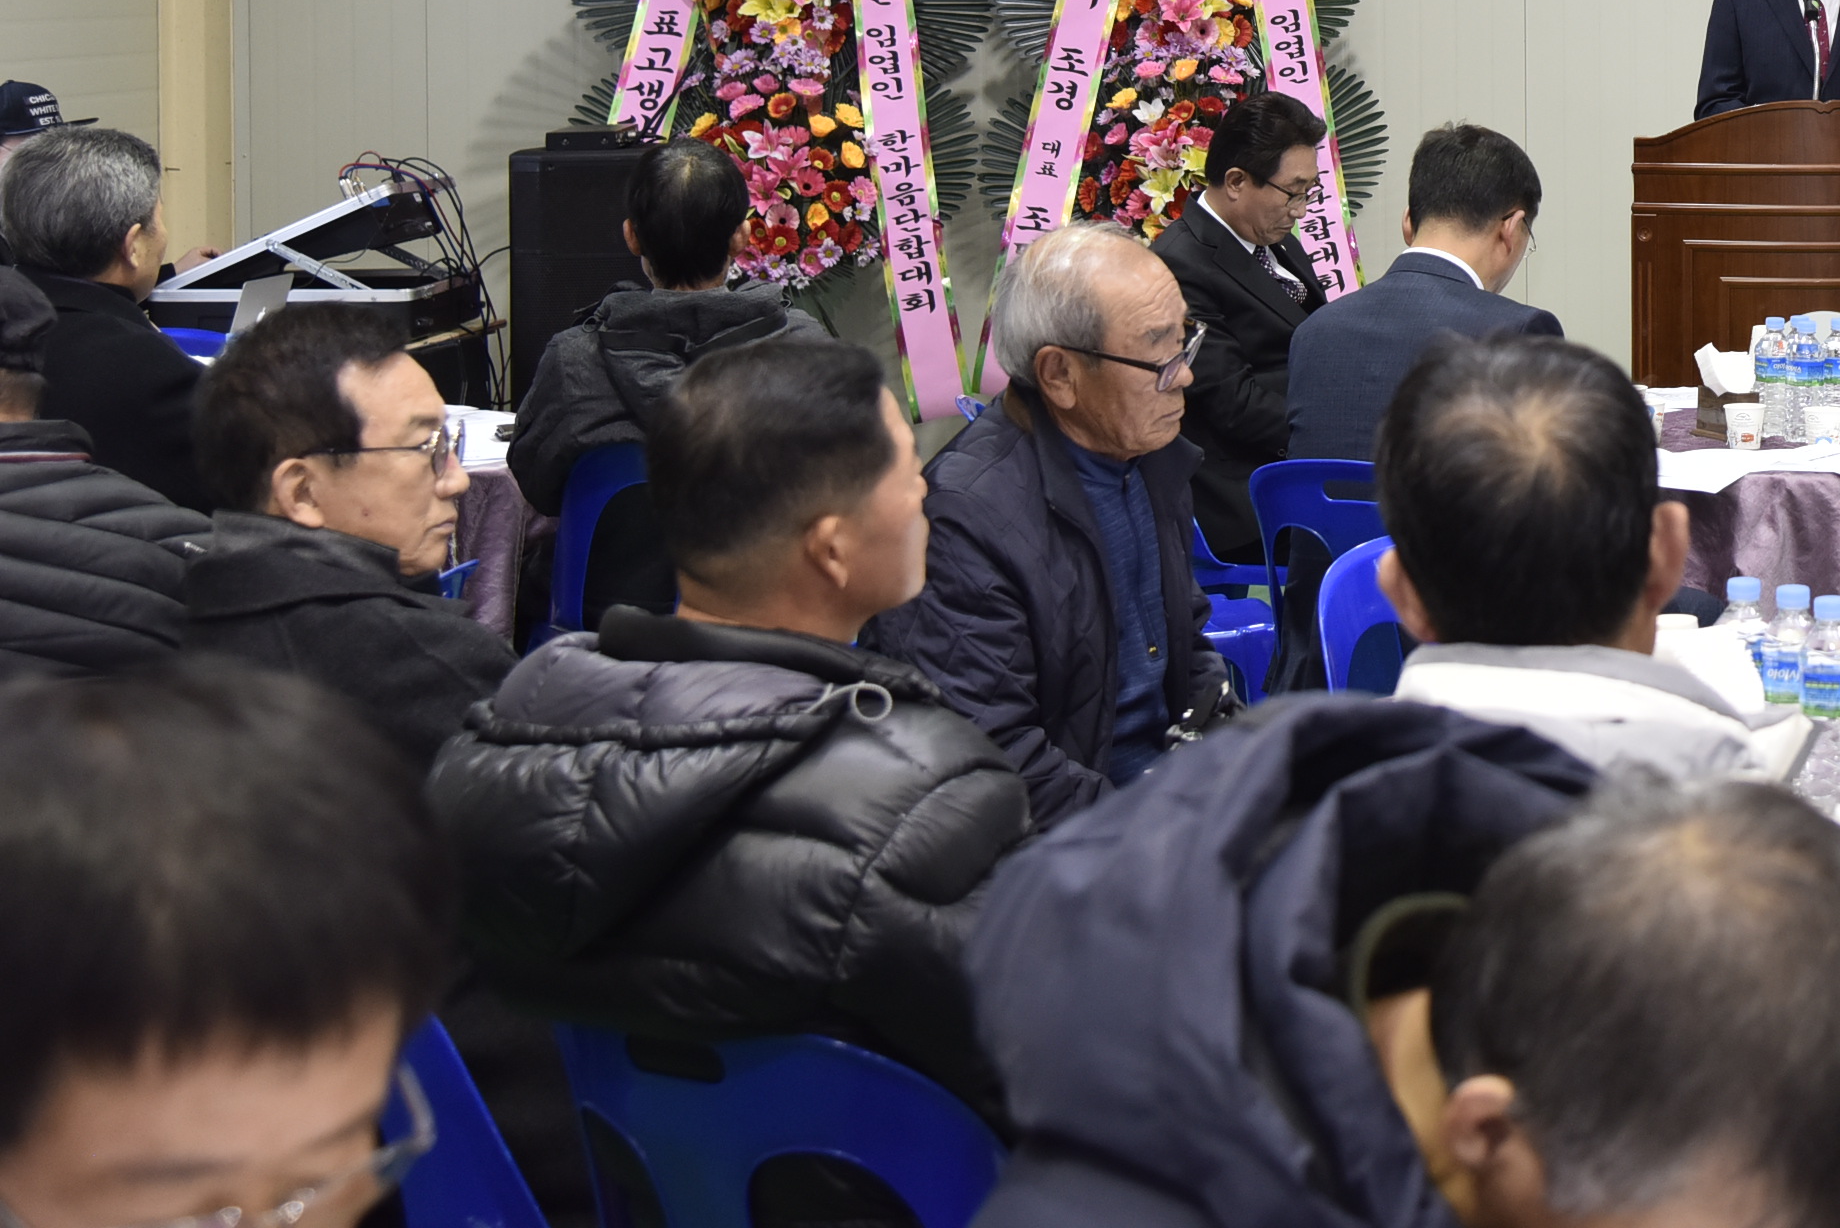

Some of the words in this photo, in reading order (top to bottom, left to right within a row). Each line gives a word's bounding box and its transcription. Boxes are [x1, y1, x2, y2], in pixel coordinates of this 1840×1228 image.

[866, 24, 905, 101] 임업인
[1270, 9, 1309, 84] 임업인
[29, 104, 56, 116] WHITE
[1047, 47, 1089, 111] 조경
[1035, 139, 1062, 178] 대표
